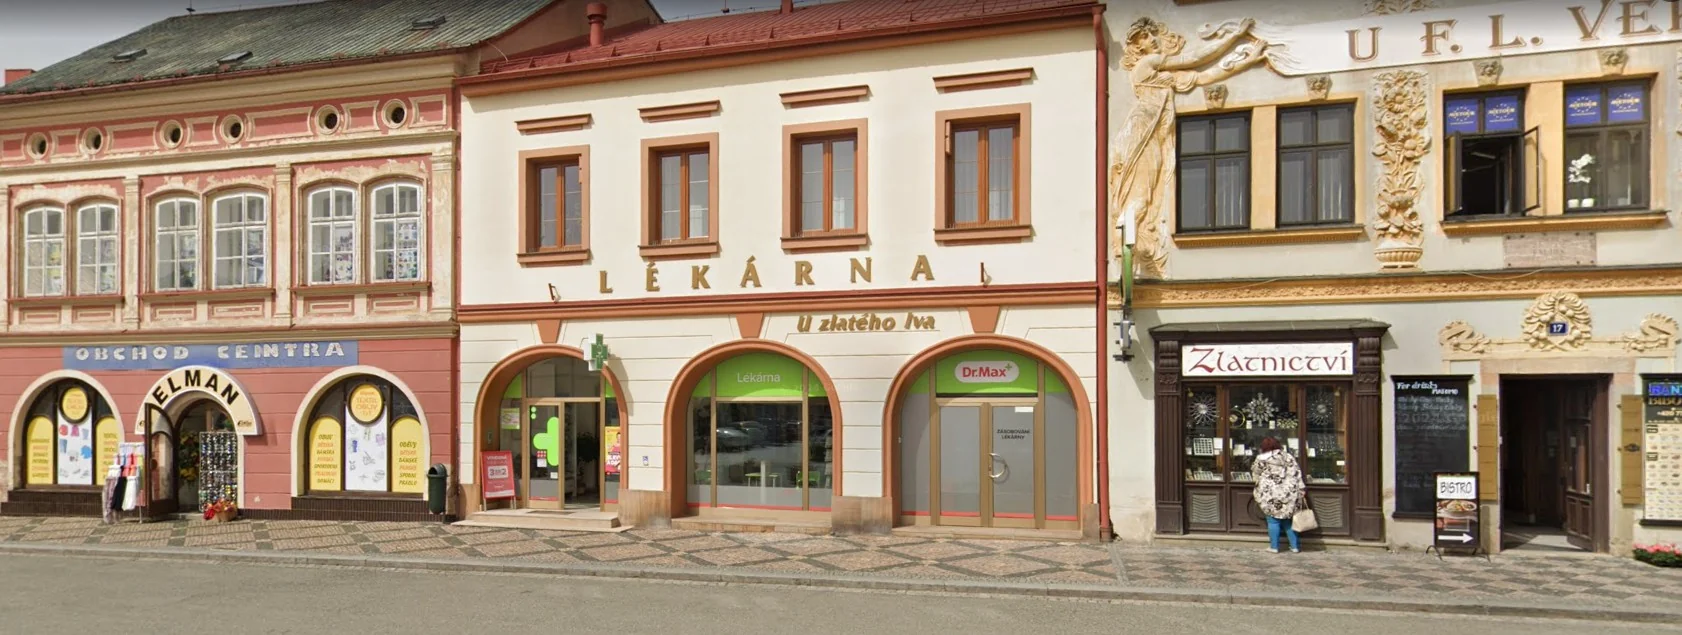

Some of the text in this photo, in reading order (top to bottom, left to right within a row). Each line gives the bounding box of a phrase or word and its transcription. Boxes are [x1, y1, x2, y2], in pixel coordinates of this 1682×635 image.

[1344, 27, 1383, 62] U
[1420, 18, 1463, 56] F.
[1487, 13, 1544, 49] L.
[599, 253, 935, 293] LÉKÁRNA
[797, 314, 813, 333] U
[818, 312, 897, 332] zlatého
[1552, 324, 1564, 333] 17
[75, 345, 190, 361] OBCHOD
[1188, 347, 1349, 374] Zlatnictví
[152, 369, 240, 406] ELMAN
[737, 371, 781, 383] Lékárna
[1440, 481, 1473, 495] BISTRO
